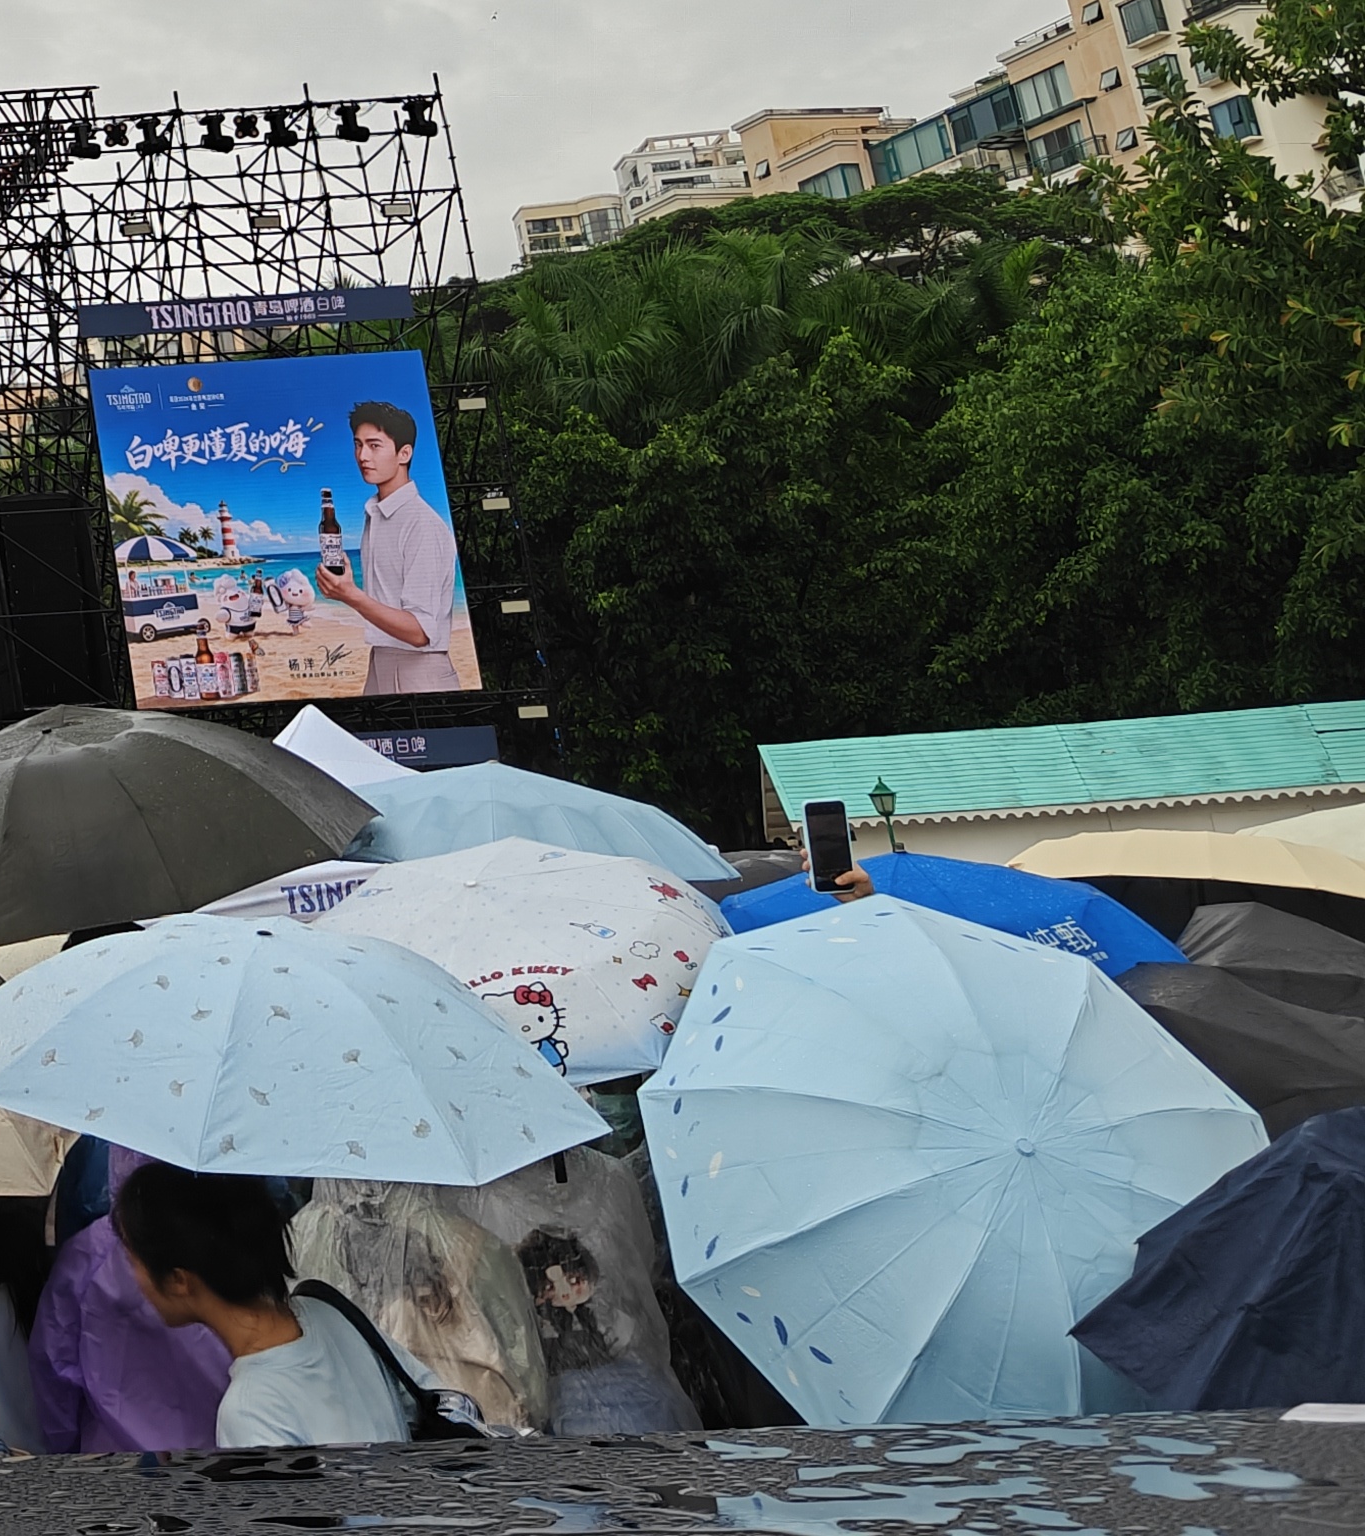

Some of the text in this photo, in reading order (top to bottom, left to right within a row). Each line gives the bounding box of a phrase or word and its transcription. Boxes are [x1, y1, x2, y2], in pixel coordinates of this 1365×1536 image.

[145, 301, 251, 329] TSINGTAO
[106, 393, 151, 405] TSINGTAO
[125, 418, 310, 472] 白啤更懂夏的嗨
[281, 879, 367, 914] TSIN
